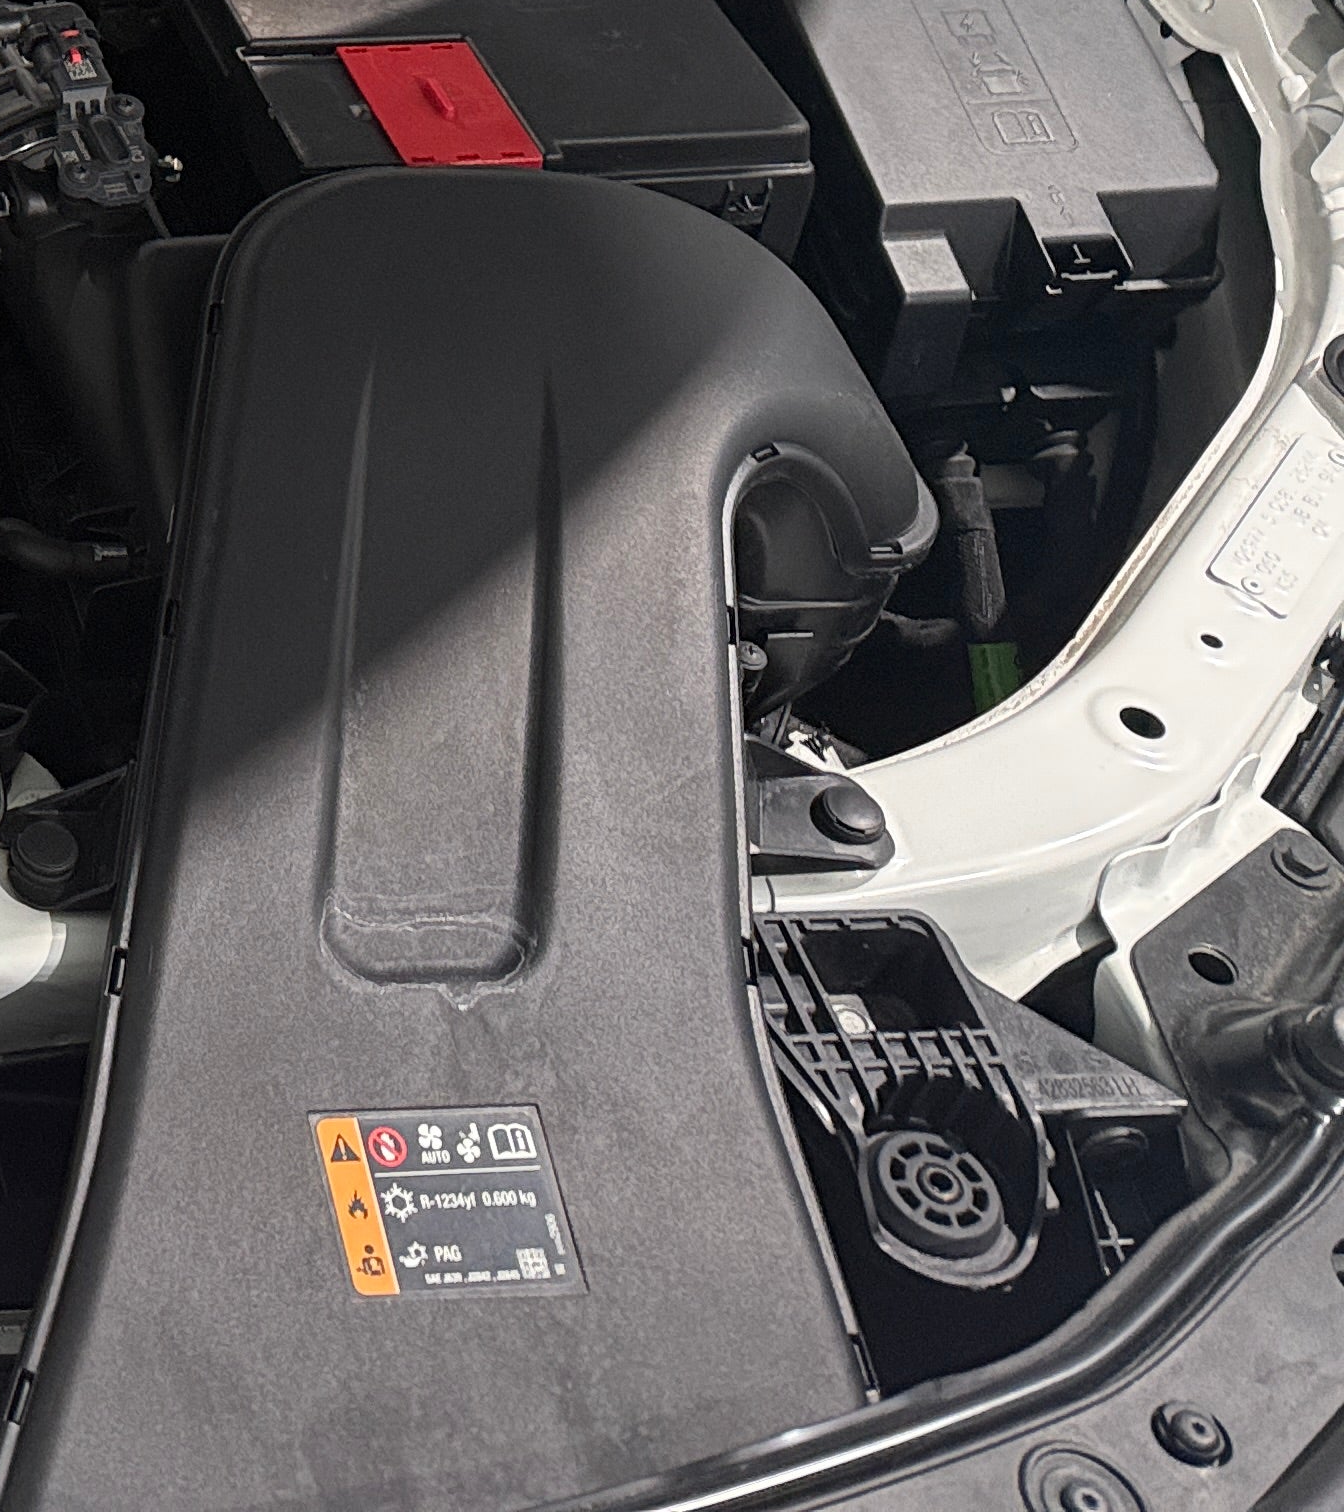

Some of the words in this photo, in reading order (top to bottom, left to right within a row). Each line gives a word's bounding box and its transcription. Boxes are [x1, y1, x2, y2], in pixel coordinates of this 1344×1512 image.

[421, 1149, 451, 1164] AUTO
[419, 1191, 476, 1211] R-1234yf
[481, 1190, 518, 1207] 0.600
[518, 1189, 537, 1208] kg
[433, 1245, 463, 1263] PAG
